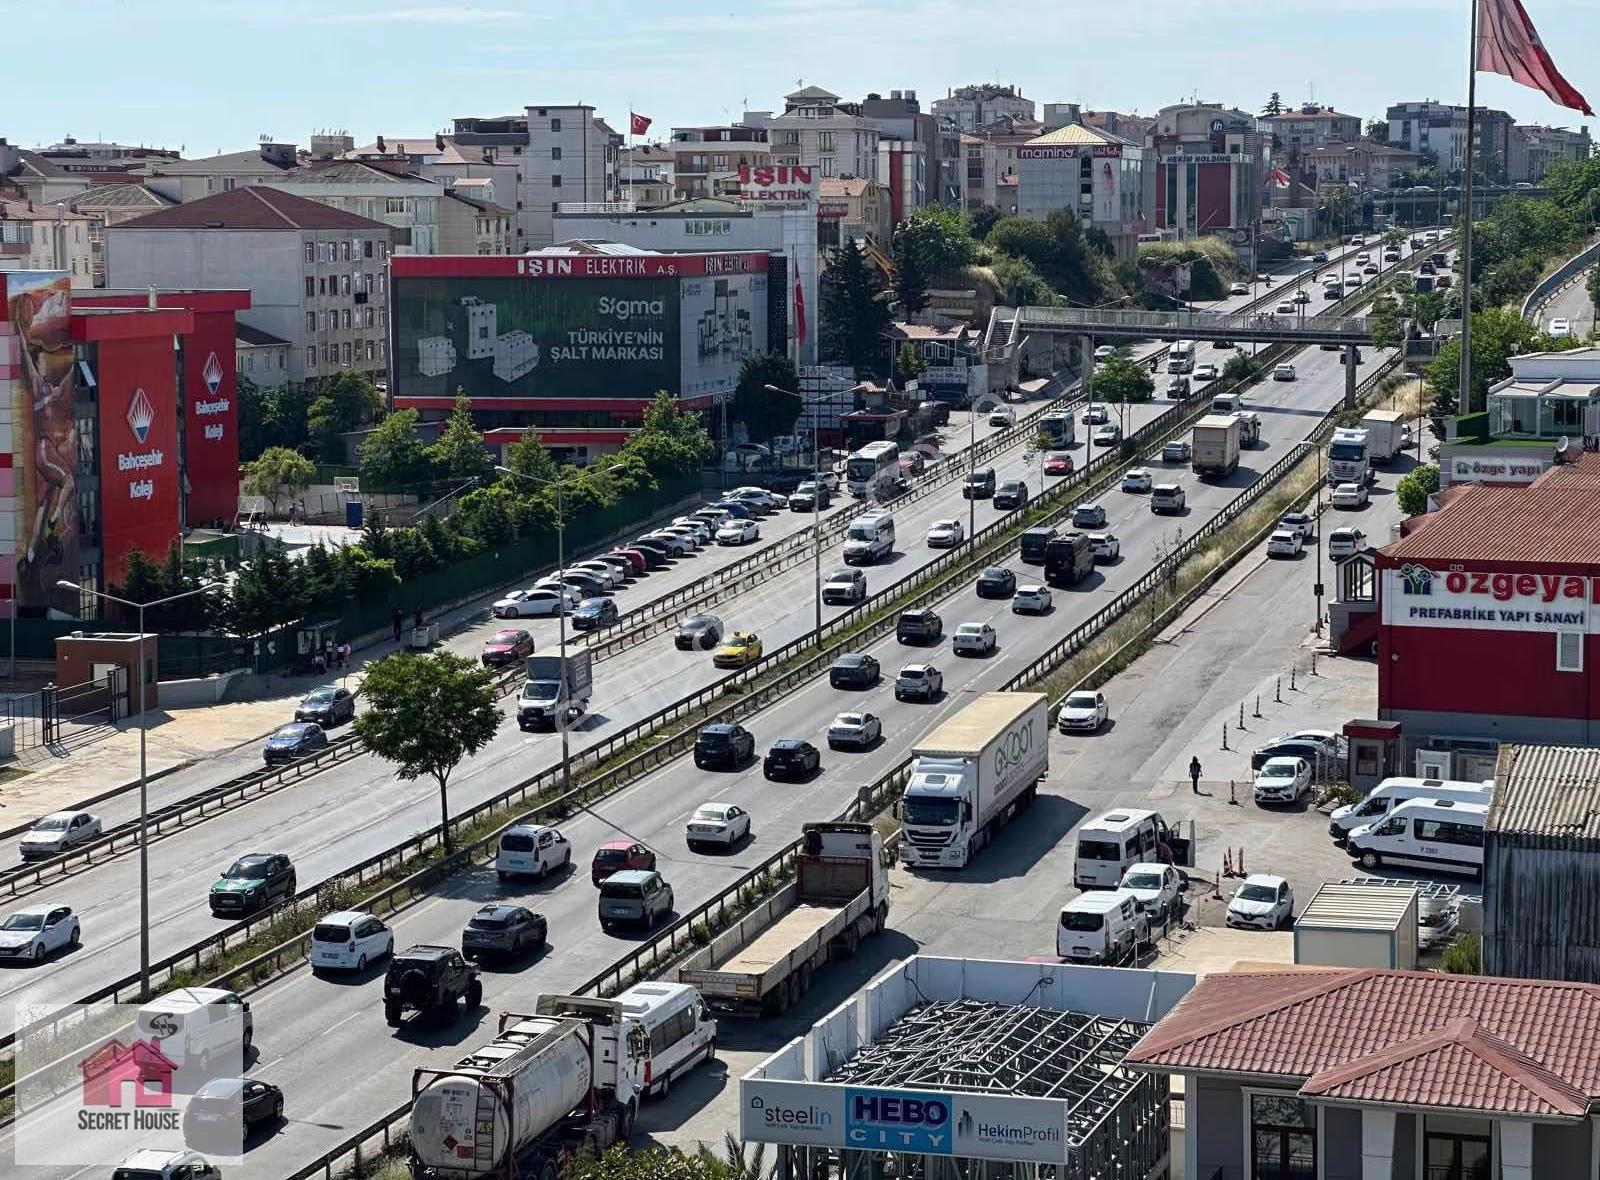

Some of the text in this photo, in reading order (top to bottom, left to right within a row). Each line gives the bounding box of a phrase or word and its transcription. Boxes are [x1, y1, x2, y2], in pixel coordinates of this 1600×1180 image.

[1021, 147, 1073, 158] mamino
[517, 259, 572, 277] IŞIN
[598, 296, 663, 320] Sigma
[550, 346, 664, 363] ŞALT MARKASI
[118, 449, 163, 470] Bahçeşehir
[1472, 461, 1506, 475] özge
[1409, 606, 1584, 625] PREFABRİKE YAPI SANAYİ
[765, 1105, 832, 1125] steelin
[851, 1095, 949, 1127] HEBO
[850, 1128, 945, 1147] CITY
[978, 1123, 1059, 1142] HekimProfil
